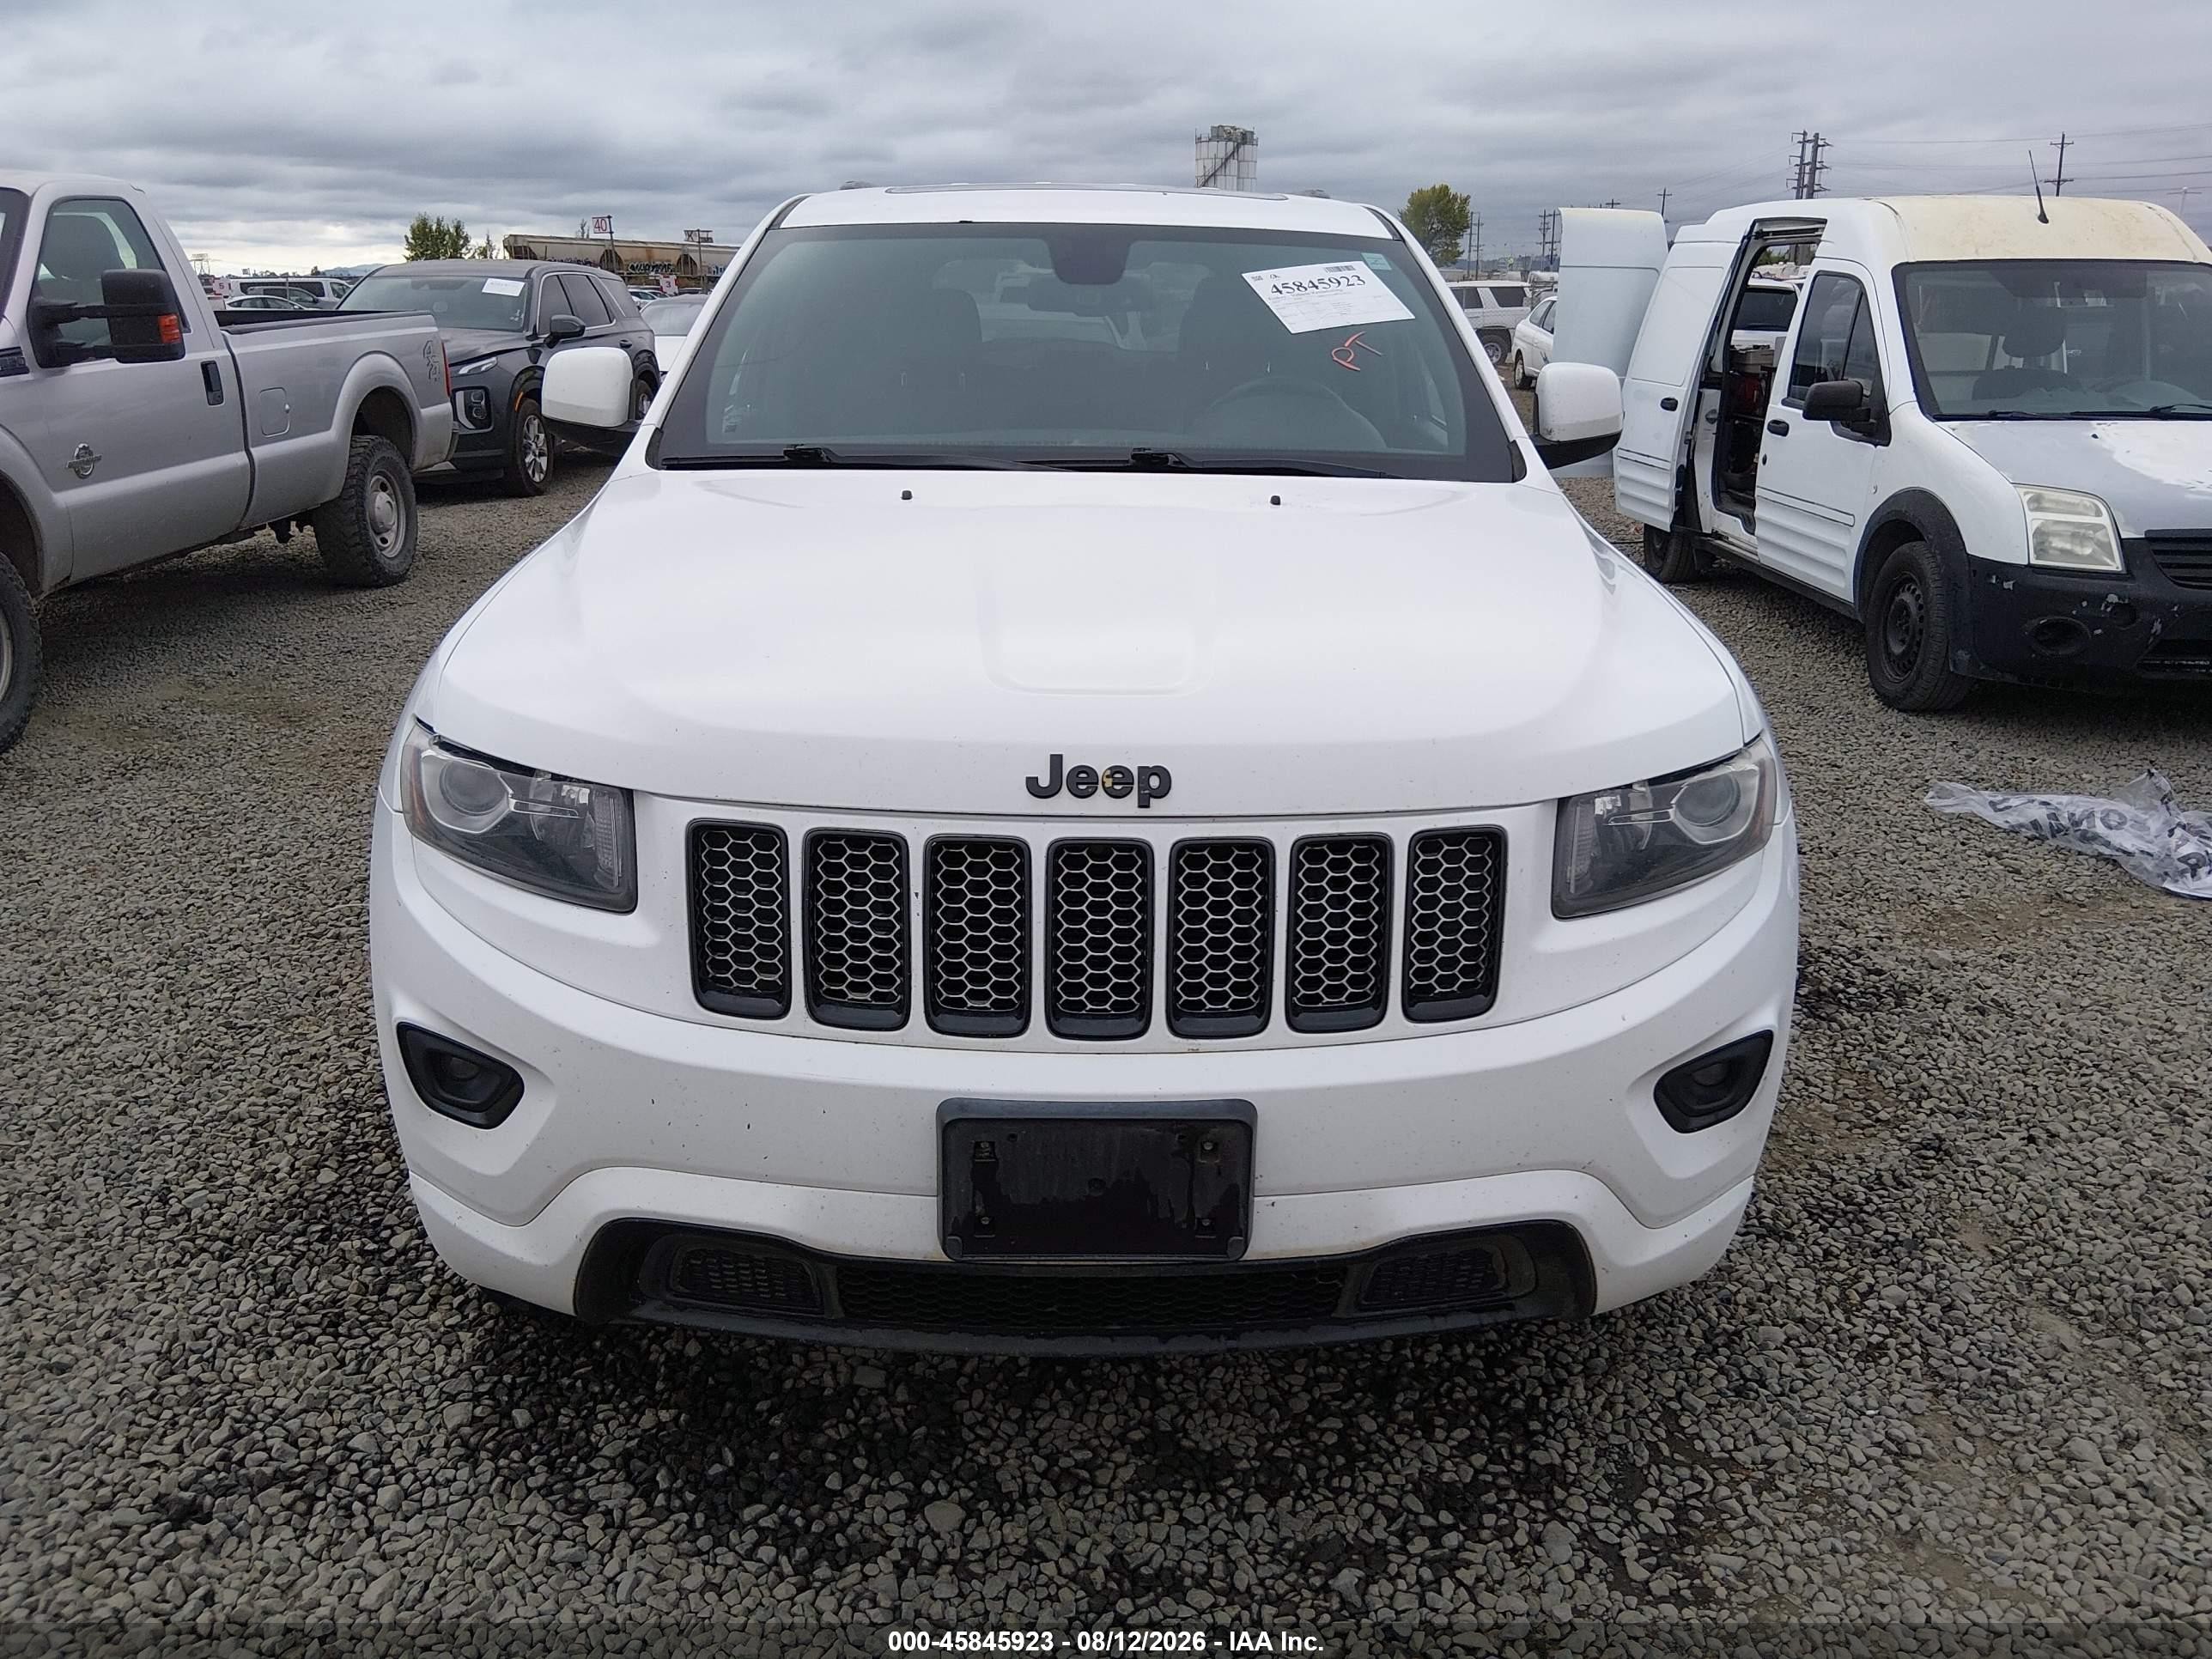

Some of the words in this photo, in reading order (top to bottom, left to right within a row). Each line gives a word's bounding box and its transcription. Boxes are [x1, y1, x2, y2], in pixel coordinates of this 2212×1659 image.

[594, 218, 607, 232] 40
[1271, 274, 1366, 295] 45845923
[1025, 753, 1171, 809] Jeep
